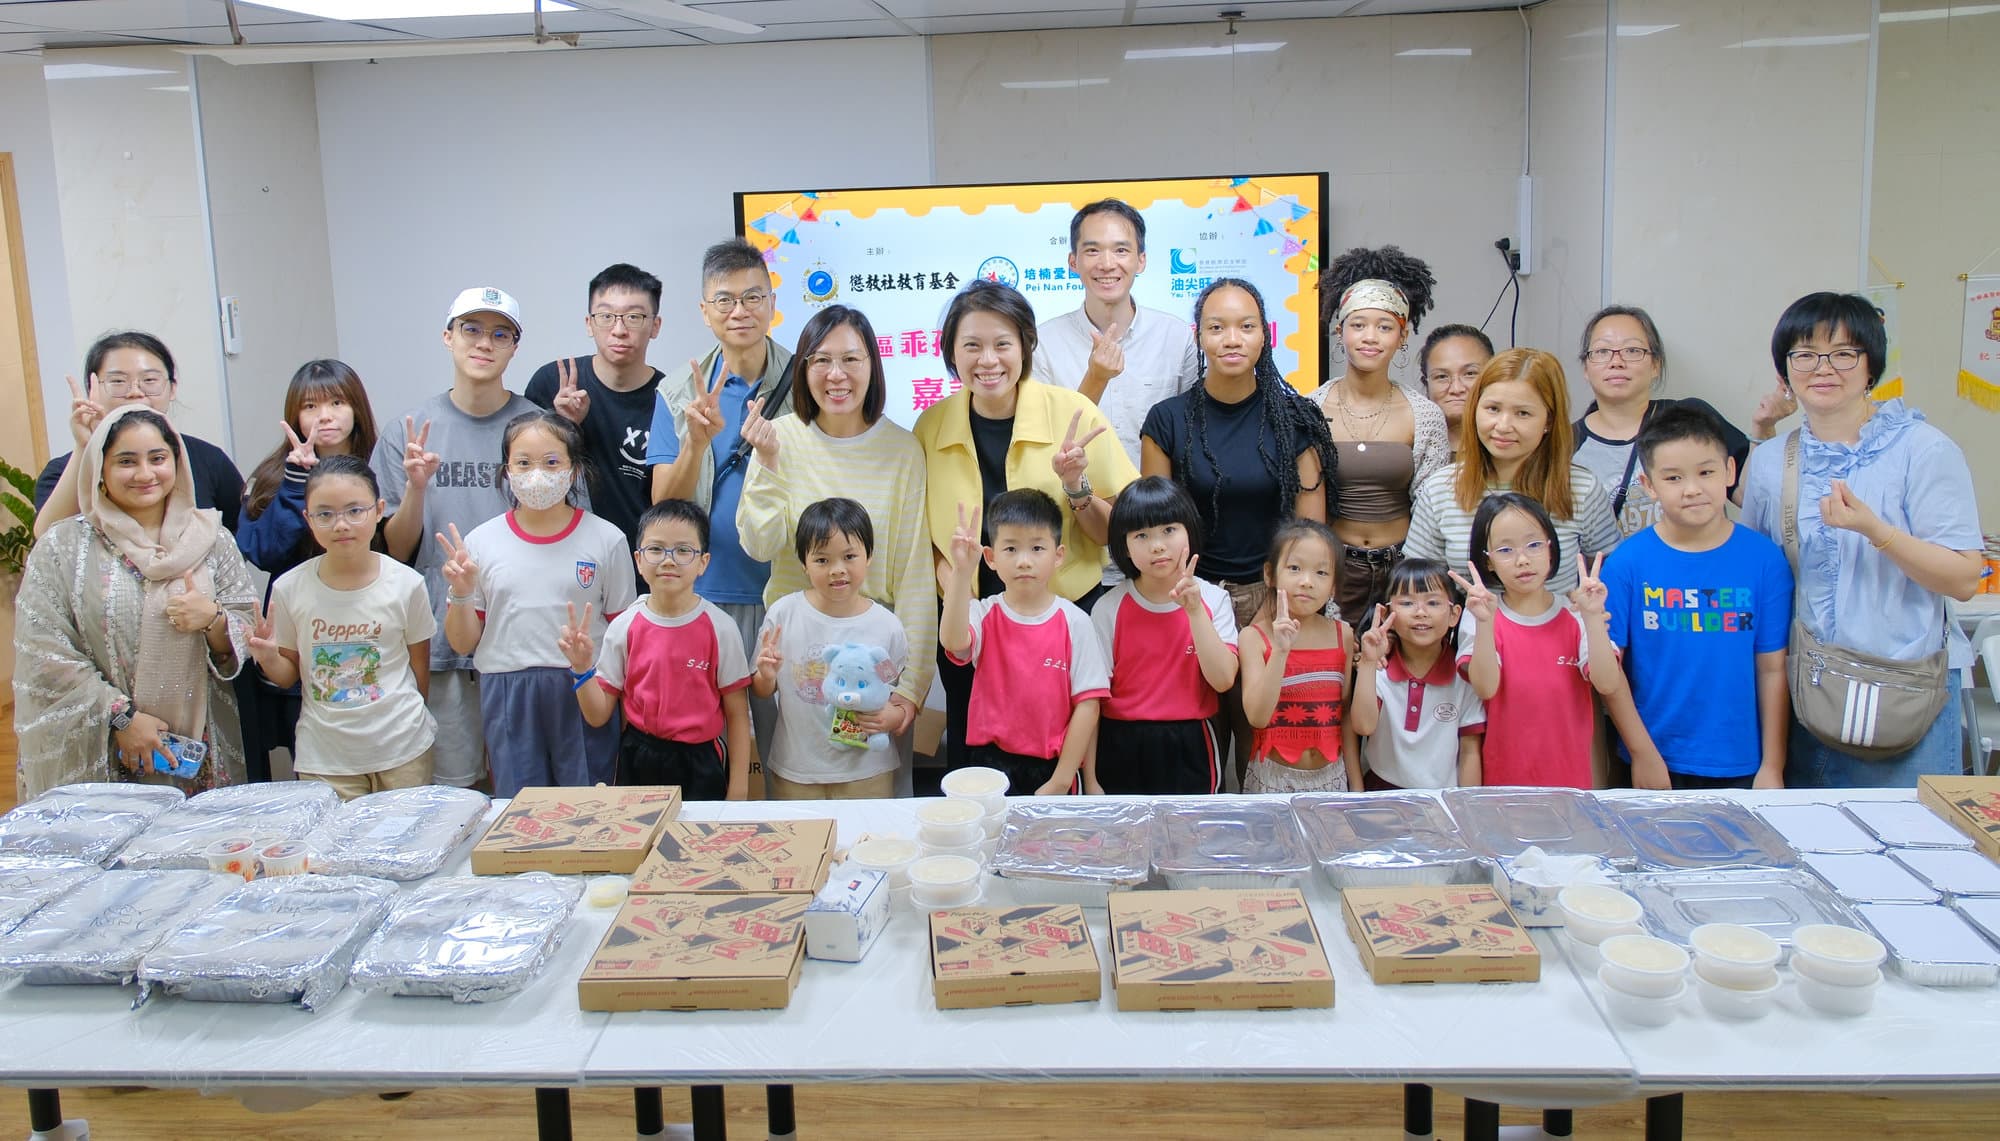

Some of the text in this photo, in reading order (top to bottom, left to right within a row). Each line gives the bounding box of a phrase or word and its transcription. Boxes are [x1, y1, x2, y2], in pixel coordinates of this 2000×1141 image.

[1026, 282, 1085, 291] Pei Nan Fou
[912, 377, 961, 411] 嘉
[1643, 587, 1752, 608] MASTER
[312, 618, 382, 641] Peppa's
[1643, 610, 1754, 632] BUILDER
